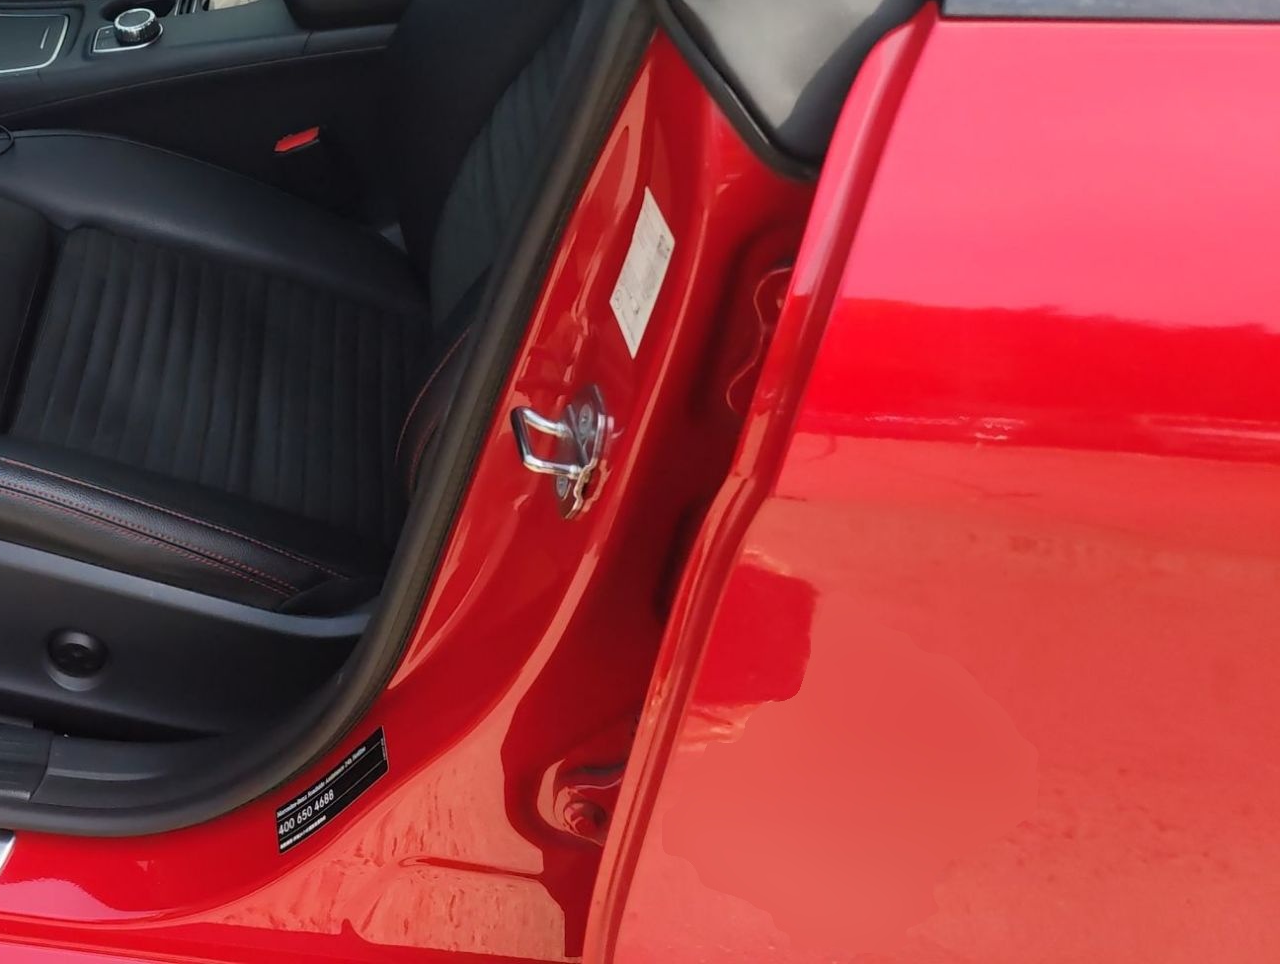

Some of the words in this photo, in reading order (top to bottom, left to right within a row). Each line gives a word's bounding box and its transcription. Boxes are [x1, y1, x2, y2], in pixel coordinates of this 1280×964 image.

[278, 817, 295, 835] 400
[297, 806, 313, 824] 650
[314, 789, 334, 811] 4688
